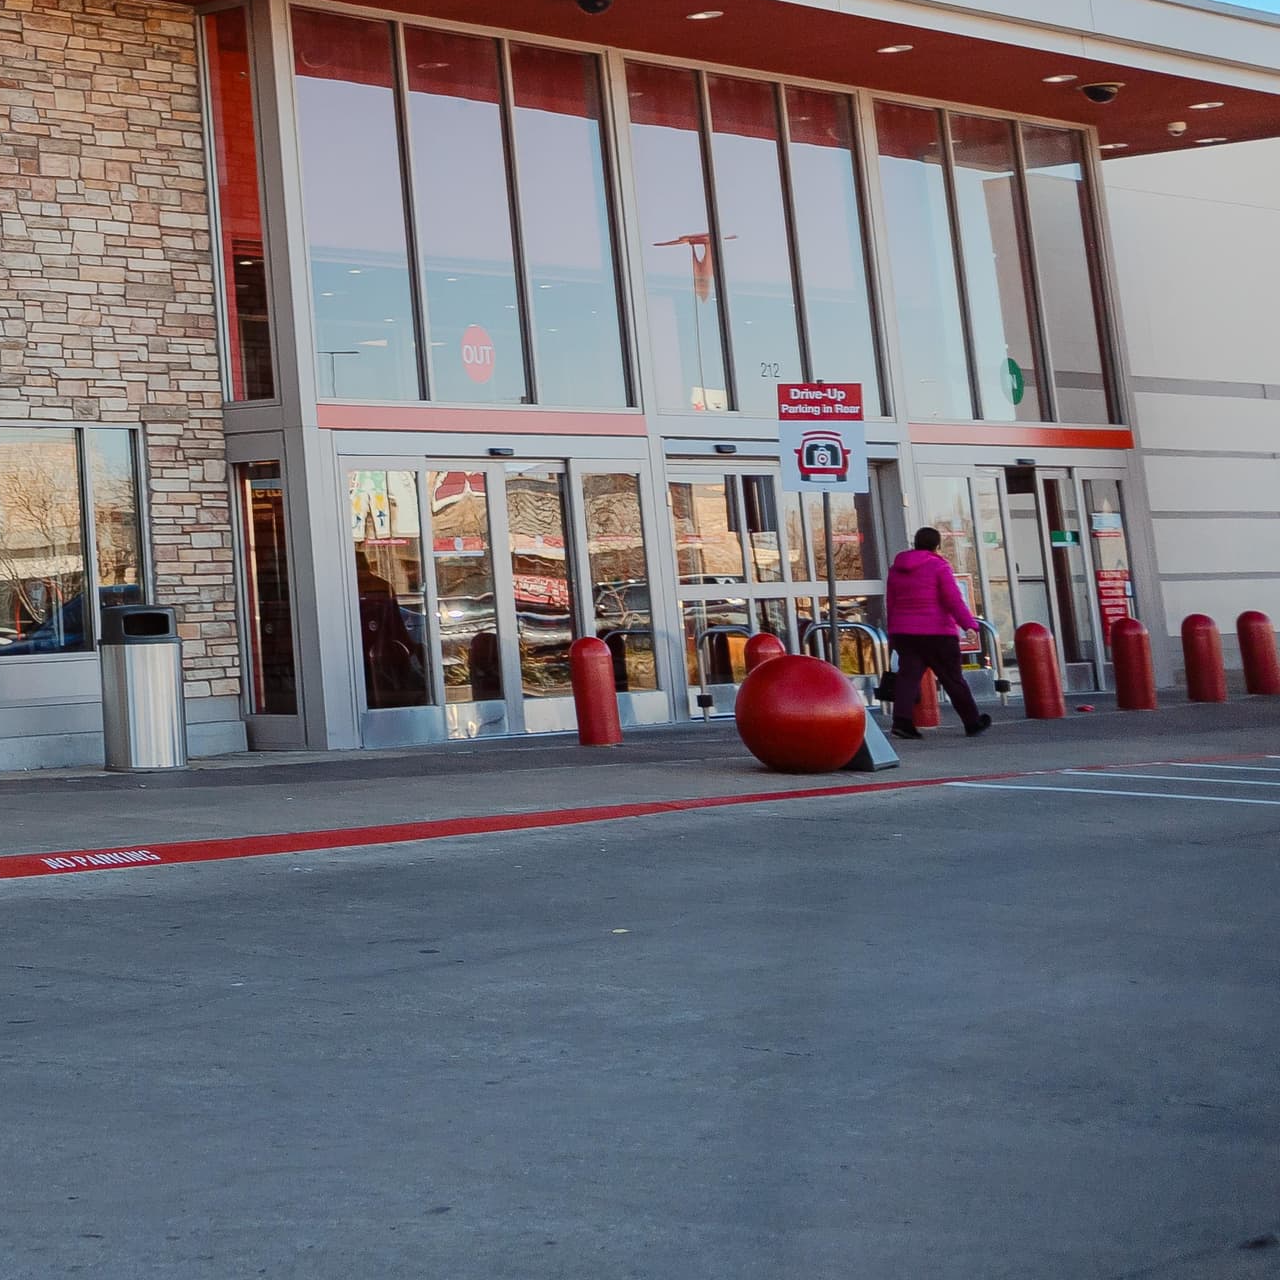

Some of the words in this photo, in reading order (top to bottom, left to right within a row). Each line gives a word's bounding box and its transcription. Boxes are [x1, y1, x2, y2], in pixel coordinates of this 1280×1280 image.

[463, 344, 492, 365] OUT
[760, 362, 780, 378] 212
[789, 388, 846, 401] Drive-Up
[780, 404, 821, 415] Parking
[823, 404, 833, 413] in
[835, 404, 860, 414] Rear
[42, 858, 76, 870] NO
[74, 850, 161, 866] PARKING
